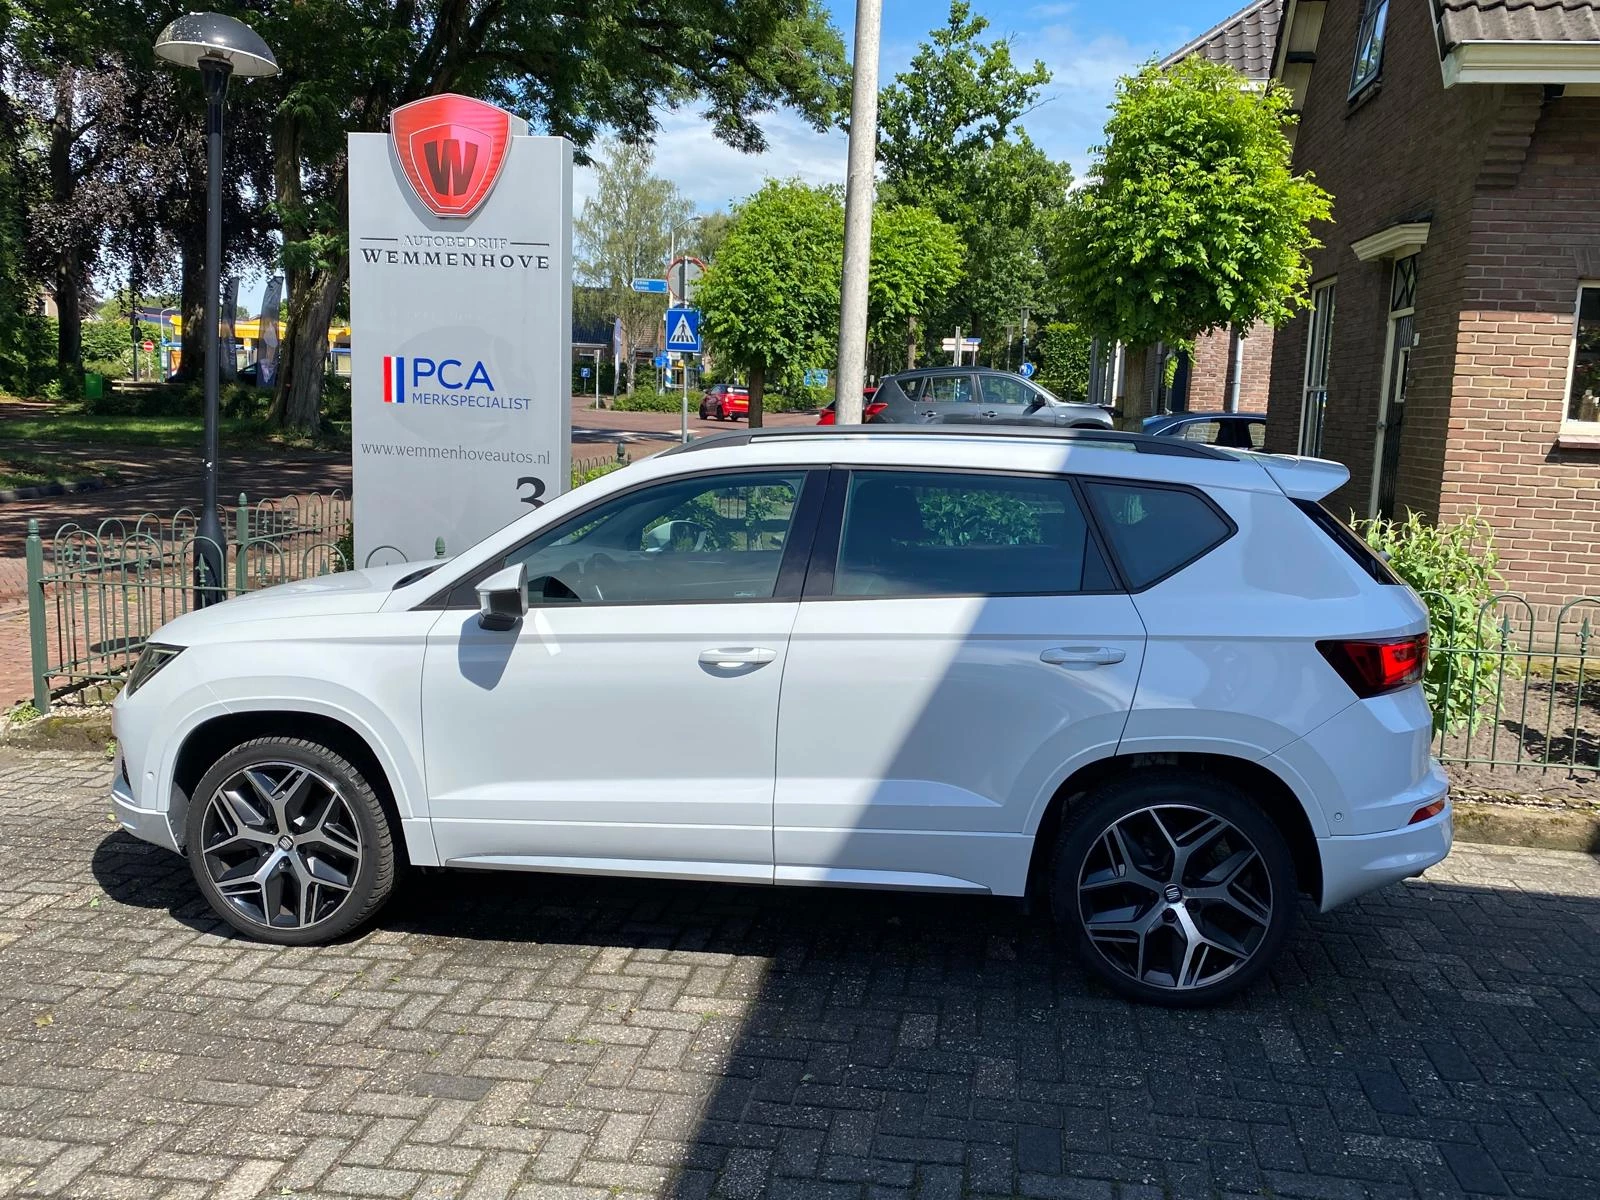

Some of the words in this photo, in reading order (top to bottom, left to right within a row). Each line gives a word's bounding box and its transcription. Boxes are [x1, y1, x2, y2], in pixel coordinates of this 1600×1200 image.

[423, 138, 479, 197] W
[403, 235, 508, 249] AUTOBEDRIJF
[360, 248, 550, 269] WEMMENHOVE
[412, 357, 495, 391] PCA
[412, 392, 532, 409] MERKSPECIALIST
[361, 443, 550, 465] www.wemmenhoveautos.nl
[515, 476, 546, 509] 3
